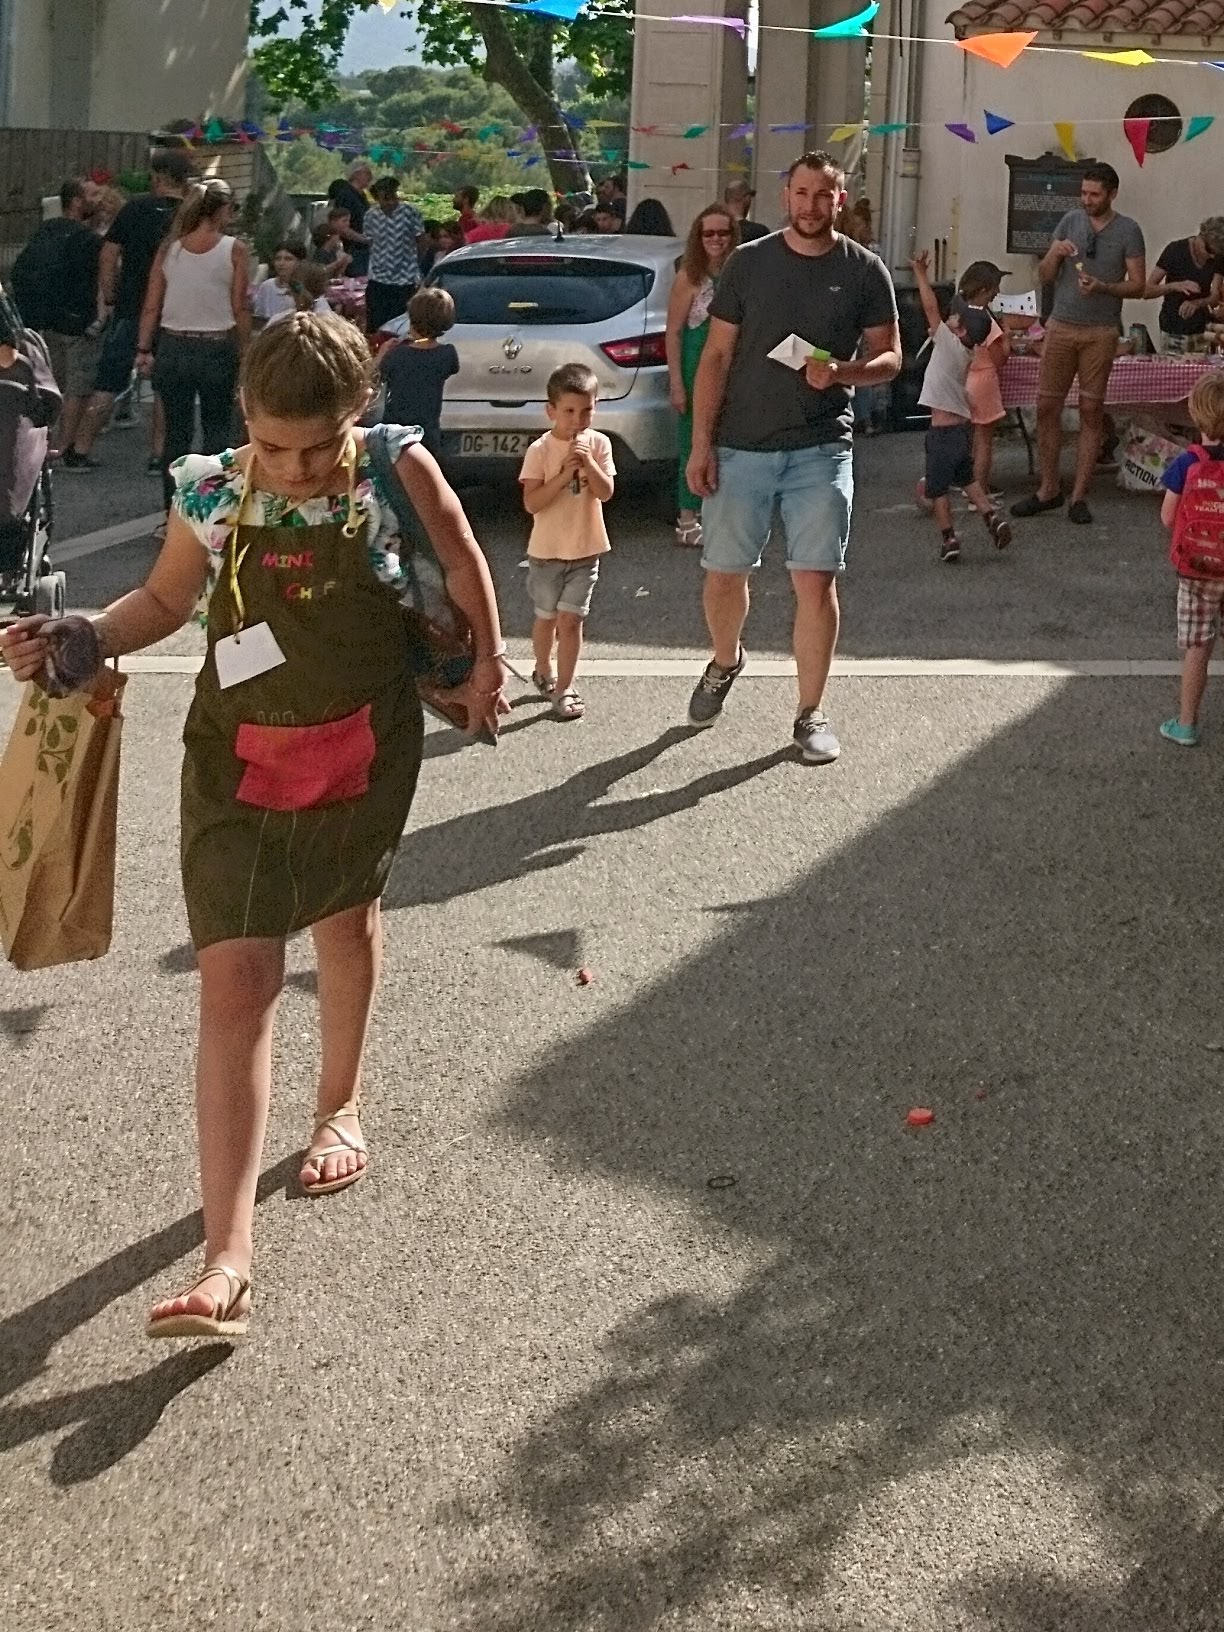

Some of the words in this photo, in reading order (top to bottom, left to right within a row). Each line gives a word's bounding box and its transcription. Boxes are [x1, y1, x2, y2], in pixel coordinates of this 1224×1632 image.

[489, 366, 532, 375] CLIO
[1125, 459, 1158, 487] ACTION
[262, 550, 313, 567] MINI
